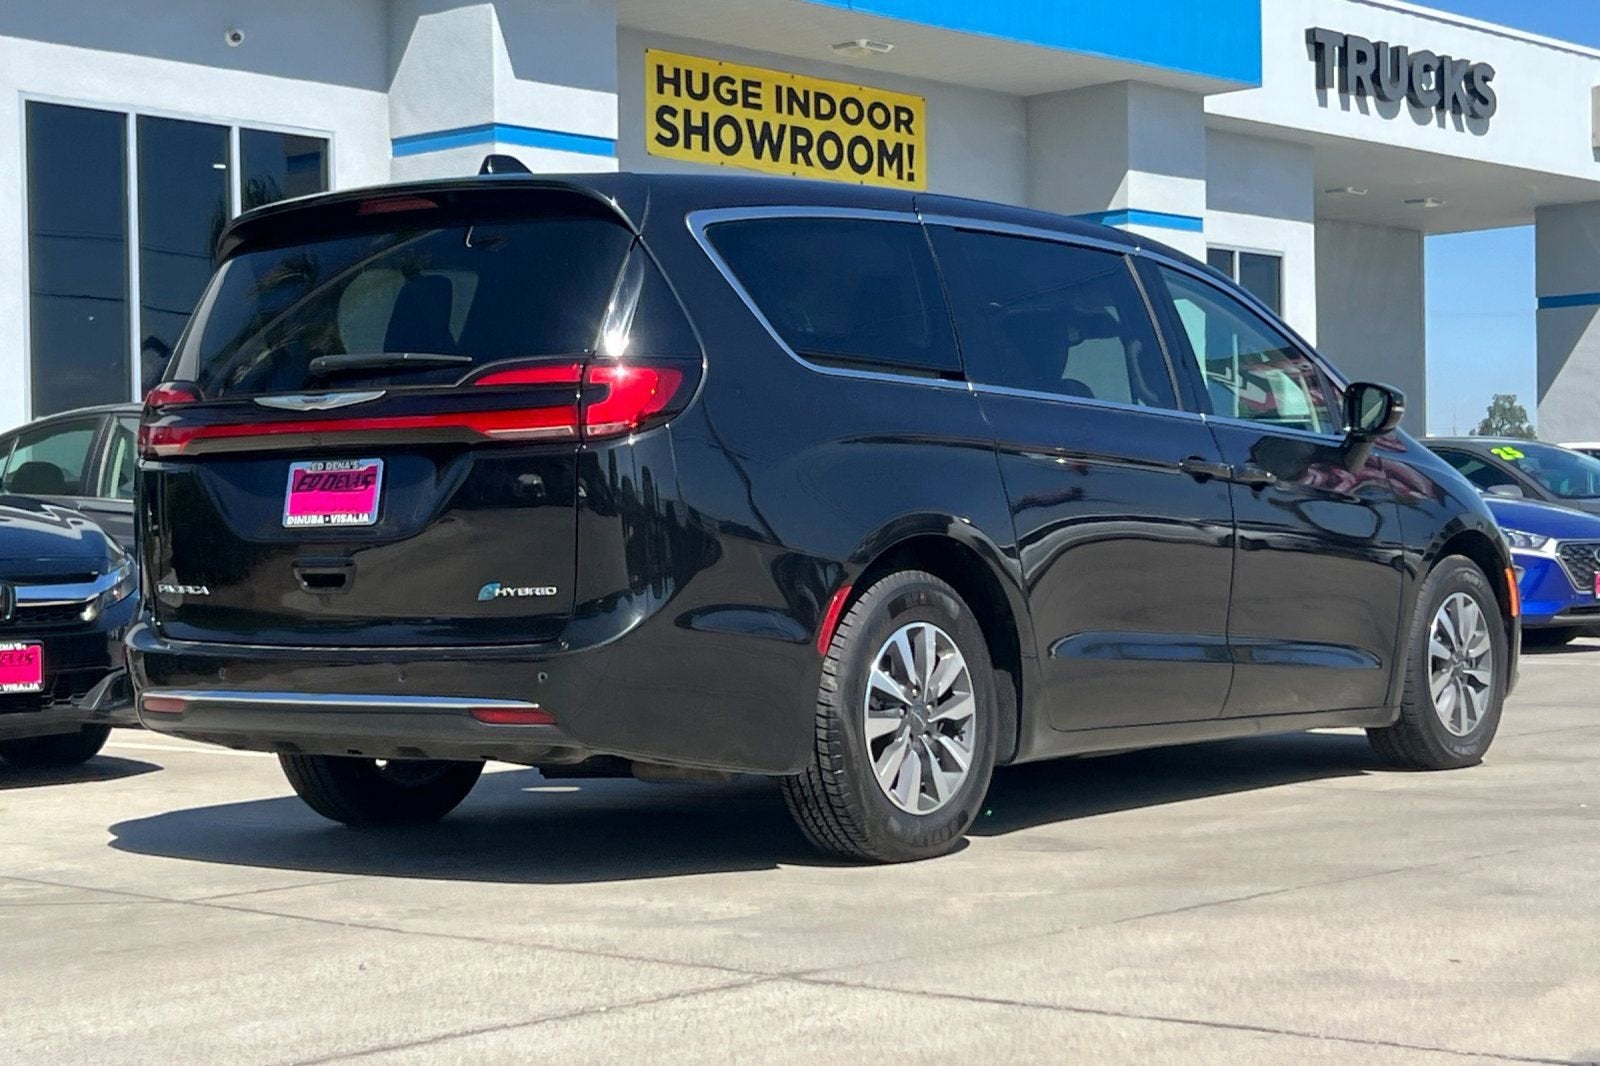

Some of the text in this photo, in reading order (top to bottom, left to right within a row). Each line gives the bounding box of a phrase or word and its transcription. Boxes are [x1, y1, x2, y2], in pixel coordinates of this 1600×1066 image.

[1305, 27, 1497, 119] TRUCKS
[656, 64, 914, 135] HUGE INDOOR
[655, 104, 915, 182] SHOWROOM!
[311, 460, 360, 470] ED DENA'S
[286, 513, 369, 525] DINUBA VISALIA
[494, 586, 557, 597] HYBRID
[2, 683, 40, 692] VISALIA
